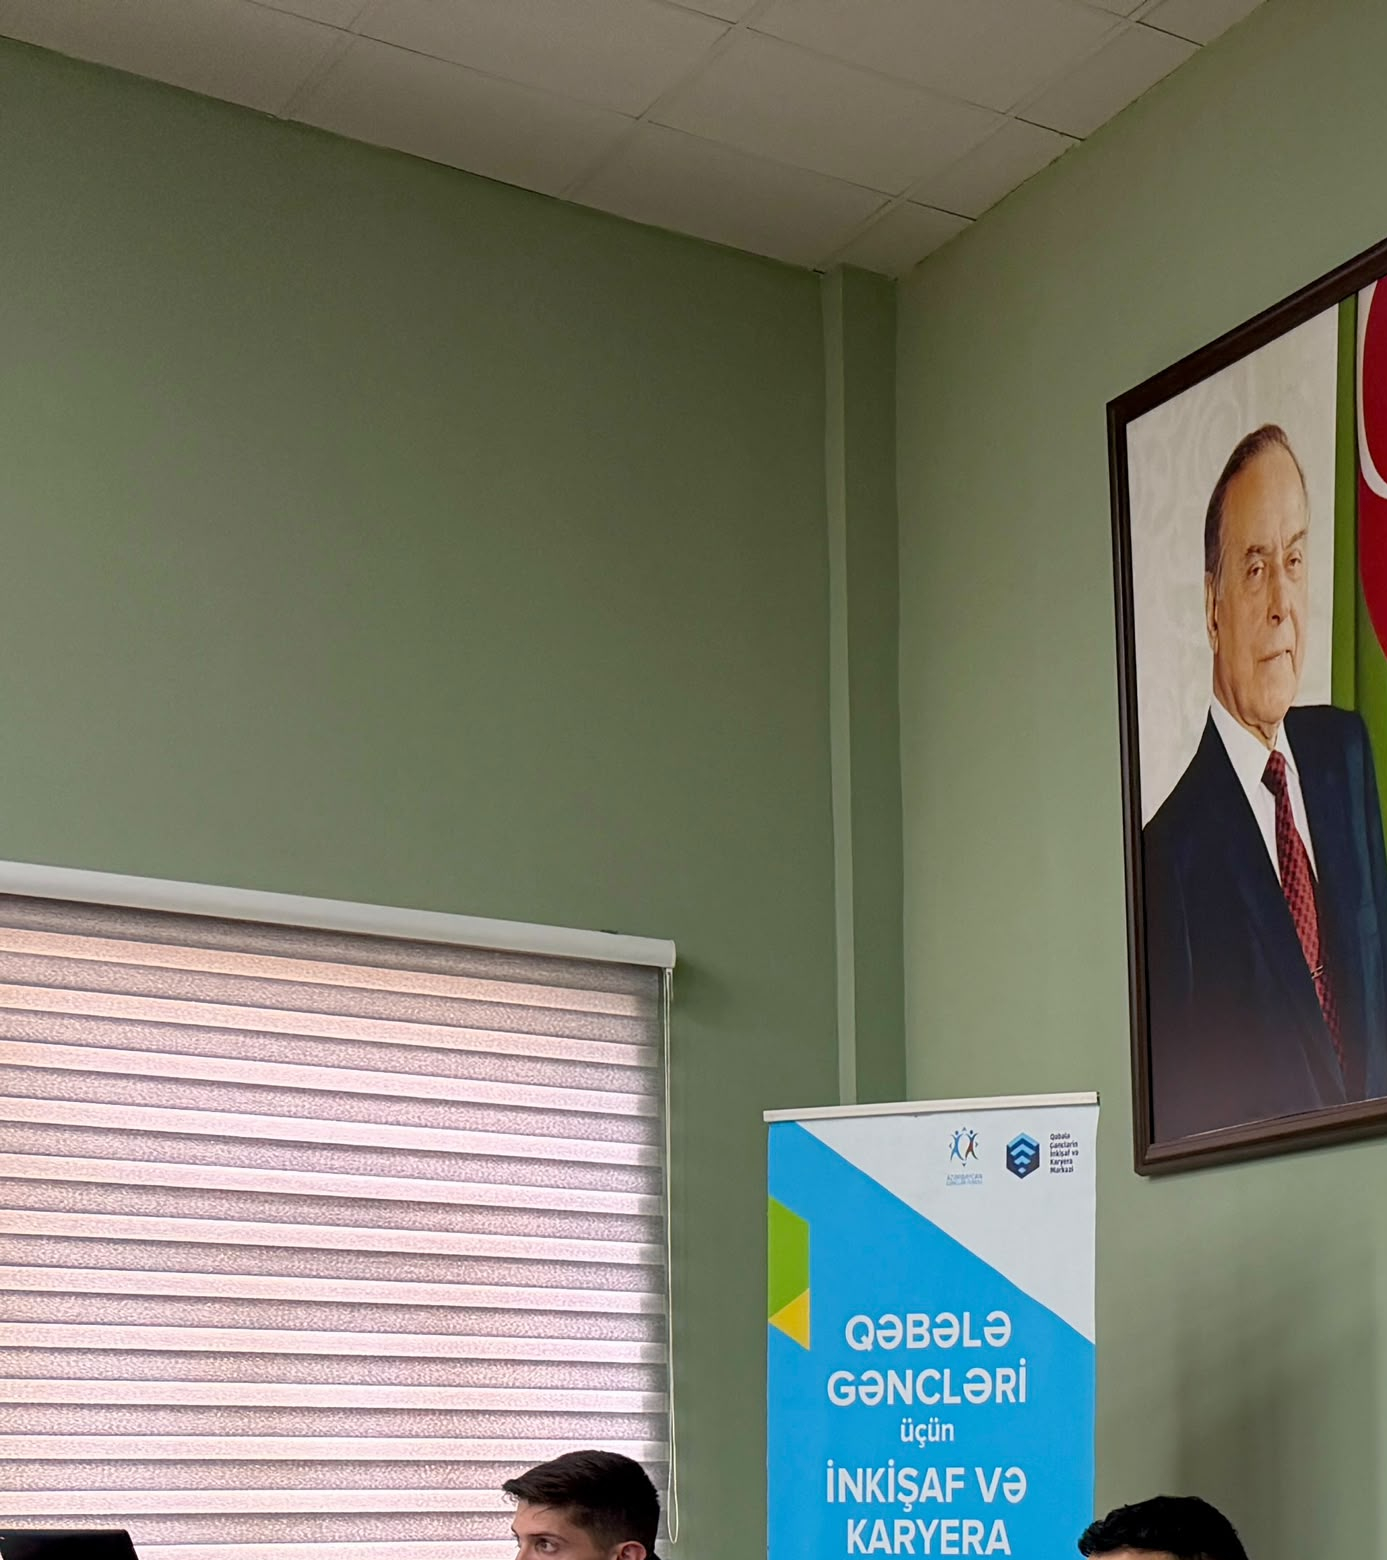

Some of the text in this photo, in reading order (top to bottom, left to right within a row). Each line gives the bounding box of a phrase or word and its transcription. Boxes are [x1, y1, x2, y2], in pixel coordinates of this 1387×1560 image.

[845, 1310, 1012, 1352] QƏBƏLƏ
[827, 1357, 1027, 1407] GƏNCLƏRİ
[900, 1417, 955, 1448] üçün
[826, 1458, 1027, 1513] İNKİŞAF VƏ
[847, 1519, 1012, 1556] KARYERA
